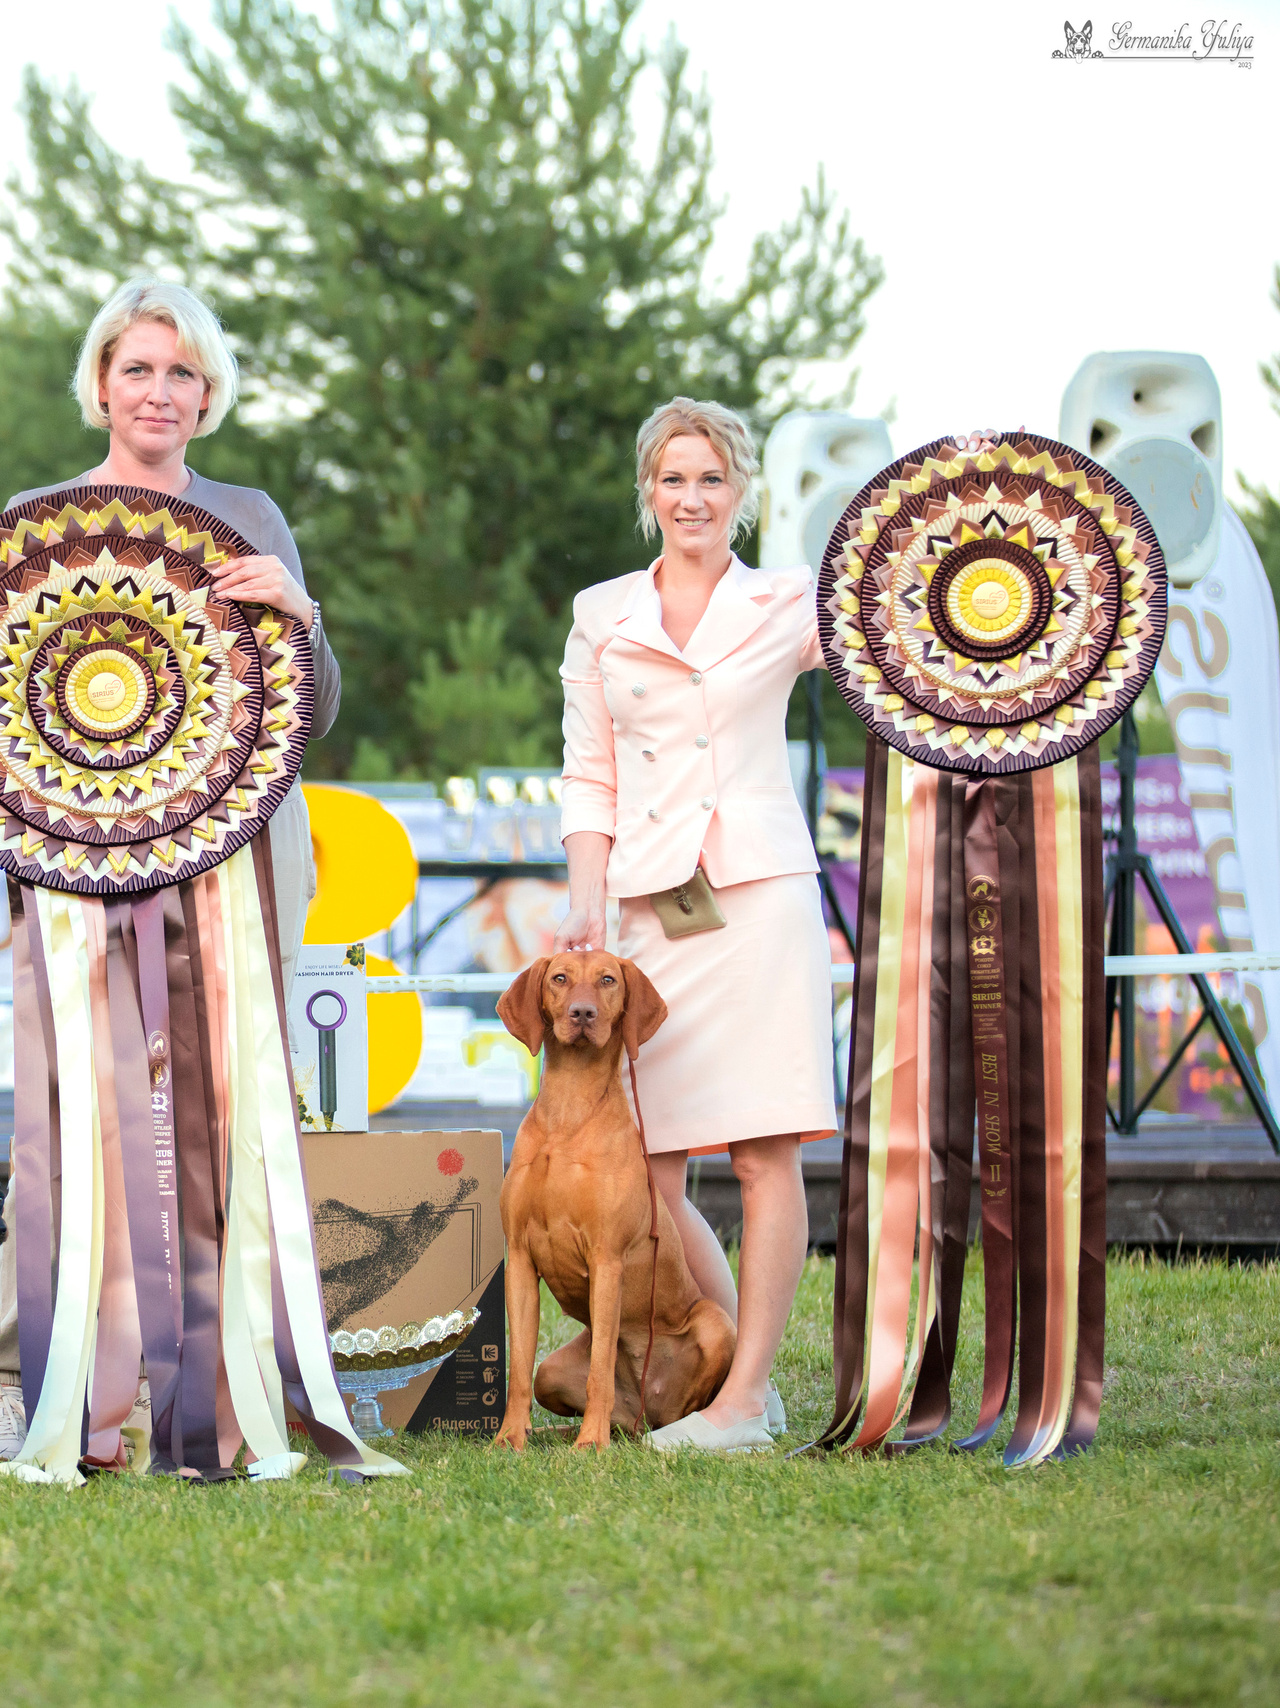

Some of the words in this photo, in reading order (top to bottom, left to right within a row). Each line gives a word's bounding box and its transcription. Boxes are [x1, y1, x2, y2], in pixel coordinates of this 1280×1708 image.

[91, 690, 115, 698] SIRIUS
[971, 992, 1002, 1001] SIRIUS
[973, 1002, 1002, 1010] WINNER
[981, 1052, 999, 1084] BEST
[983, 1089, 1000, 1108] IN
[984, 1113, 1002, 1157] SHOW
[432, 1416, 481, 1431] Яндекс
[481, 1416, 500, 1430] ТВ
